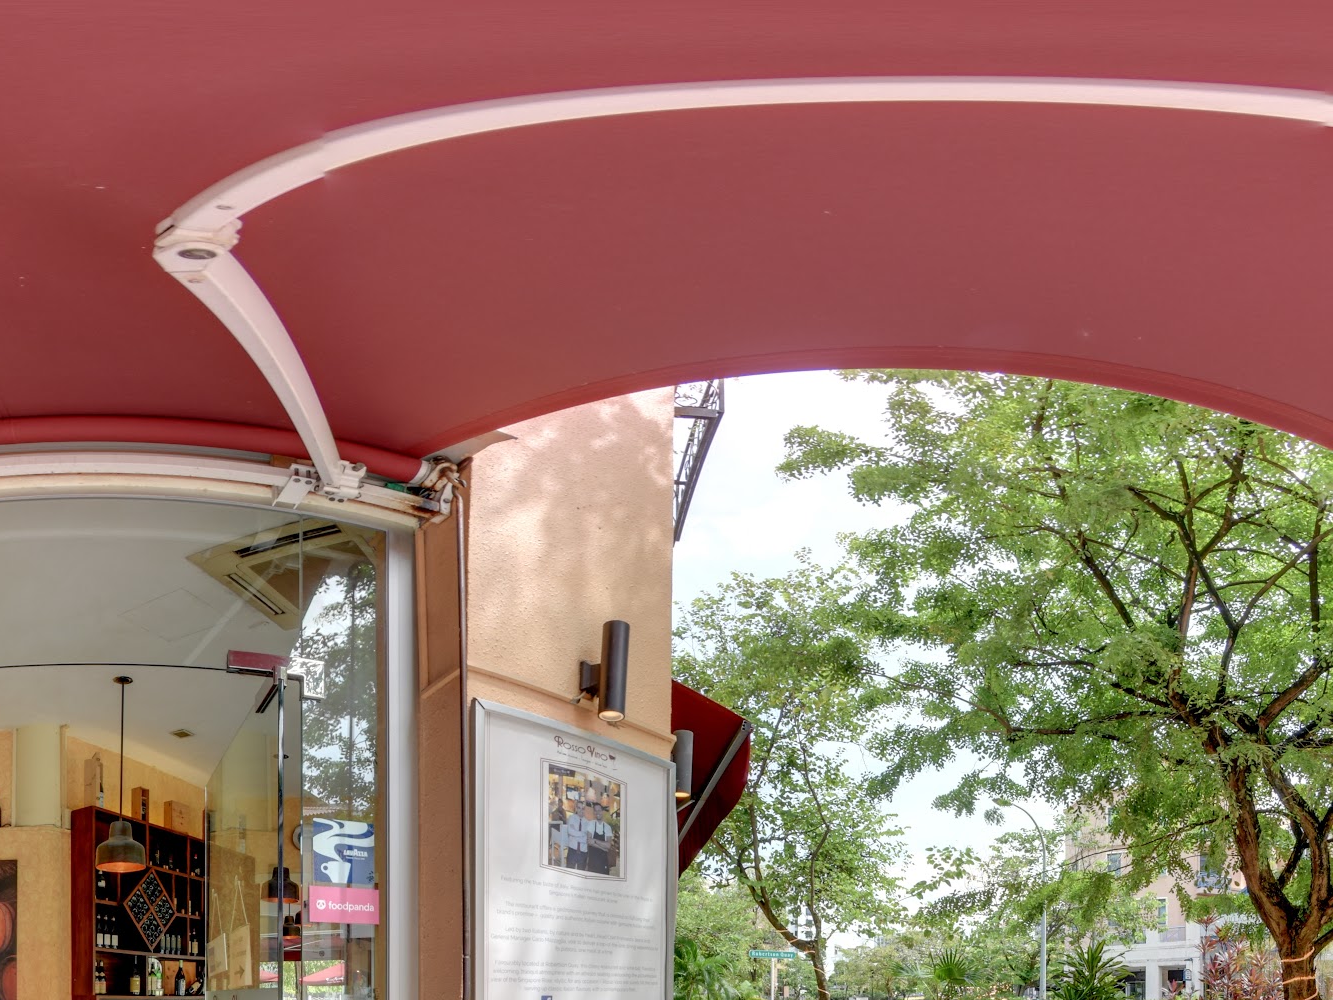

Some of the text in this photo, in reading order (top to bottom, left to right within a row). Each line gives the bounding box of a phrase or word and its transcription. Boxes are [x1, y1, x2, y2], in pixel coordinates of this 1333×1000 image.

[554, 735, 608, 761] Rosso Vino
[328, 901, 374, 912] foodpanda
